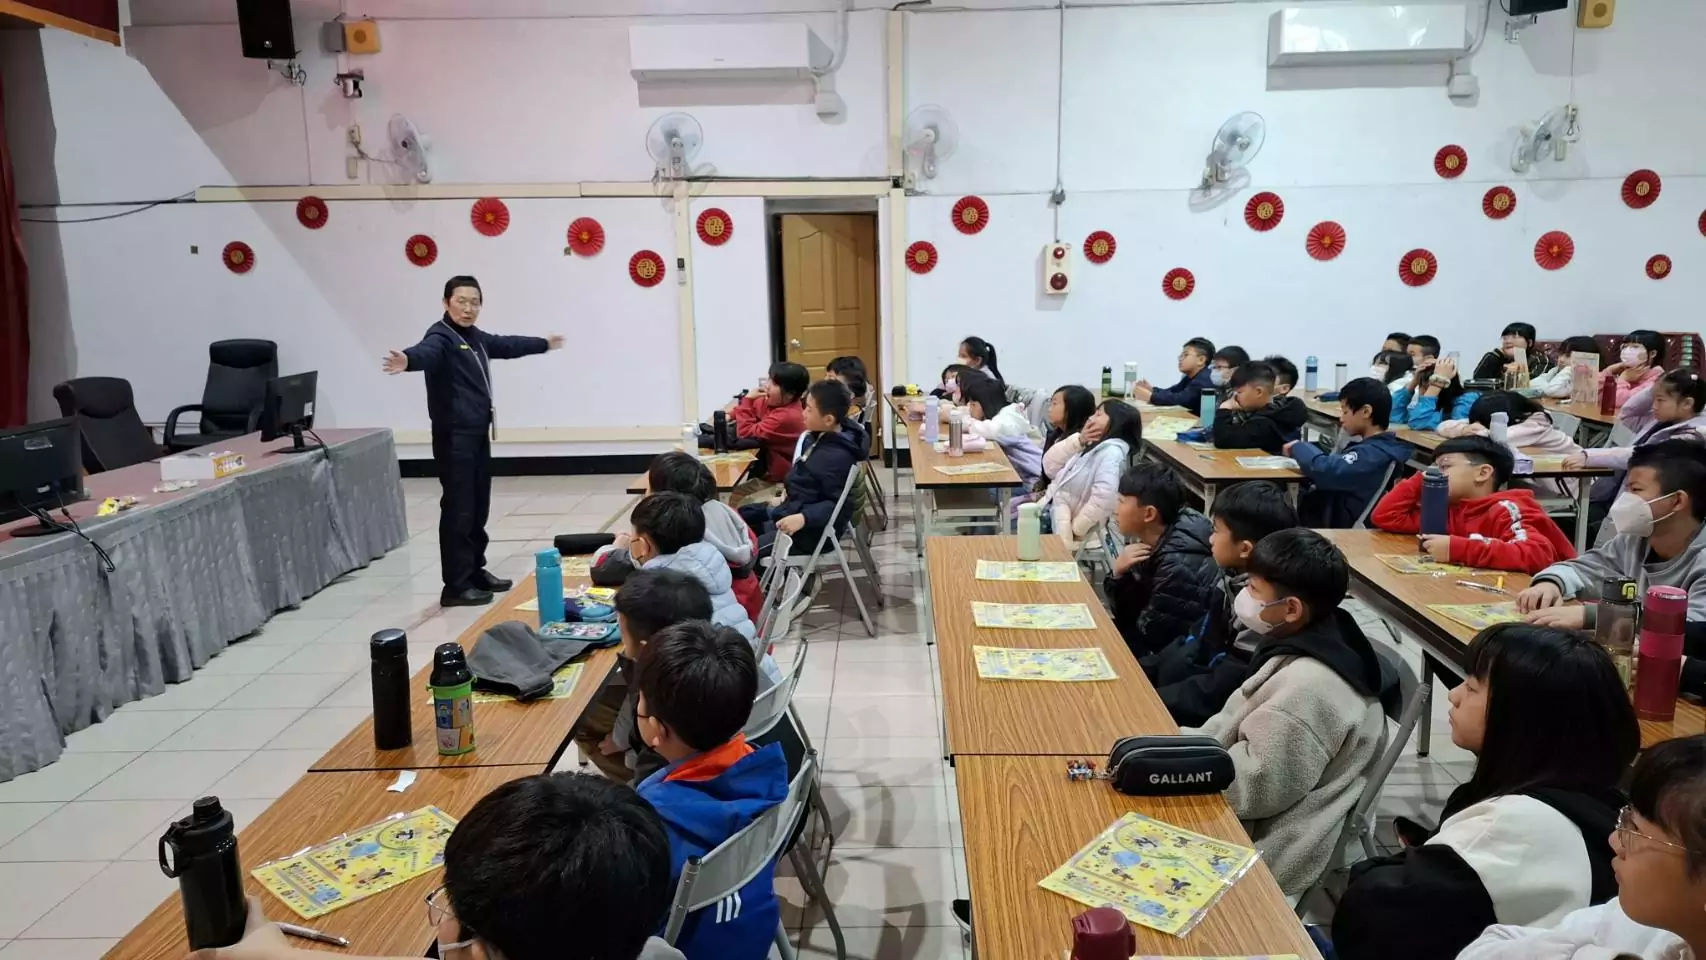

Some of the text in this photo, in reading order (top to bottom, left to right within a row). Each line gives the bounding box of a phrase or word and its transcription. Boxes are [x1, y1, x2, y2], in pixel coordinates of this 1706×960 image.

[704, 216, 724, 236] 福
[637, 259, 657, 278] 福
[1149, 771, 1213, 785] GALLANT
